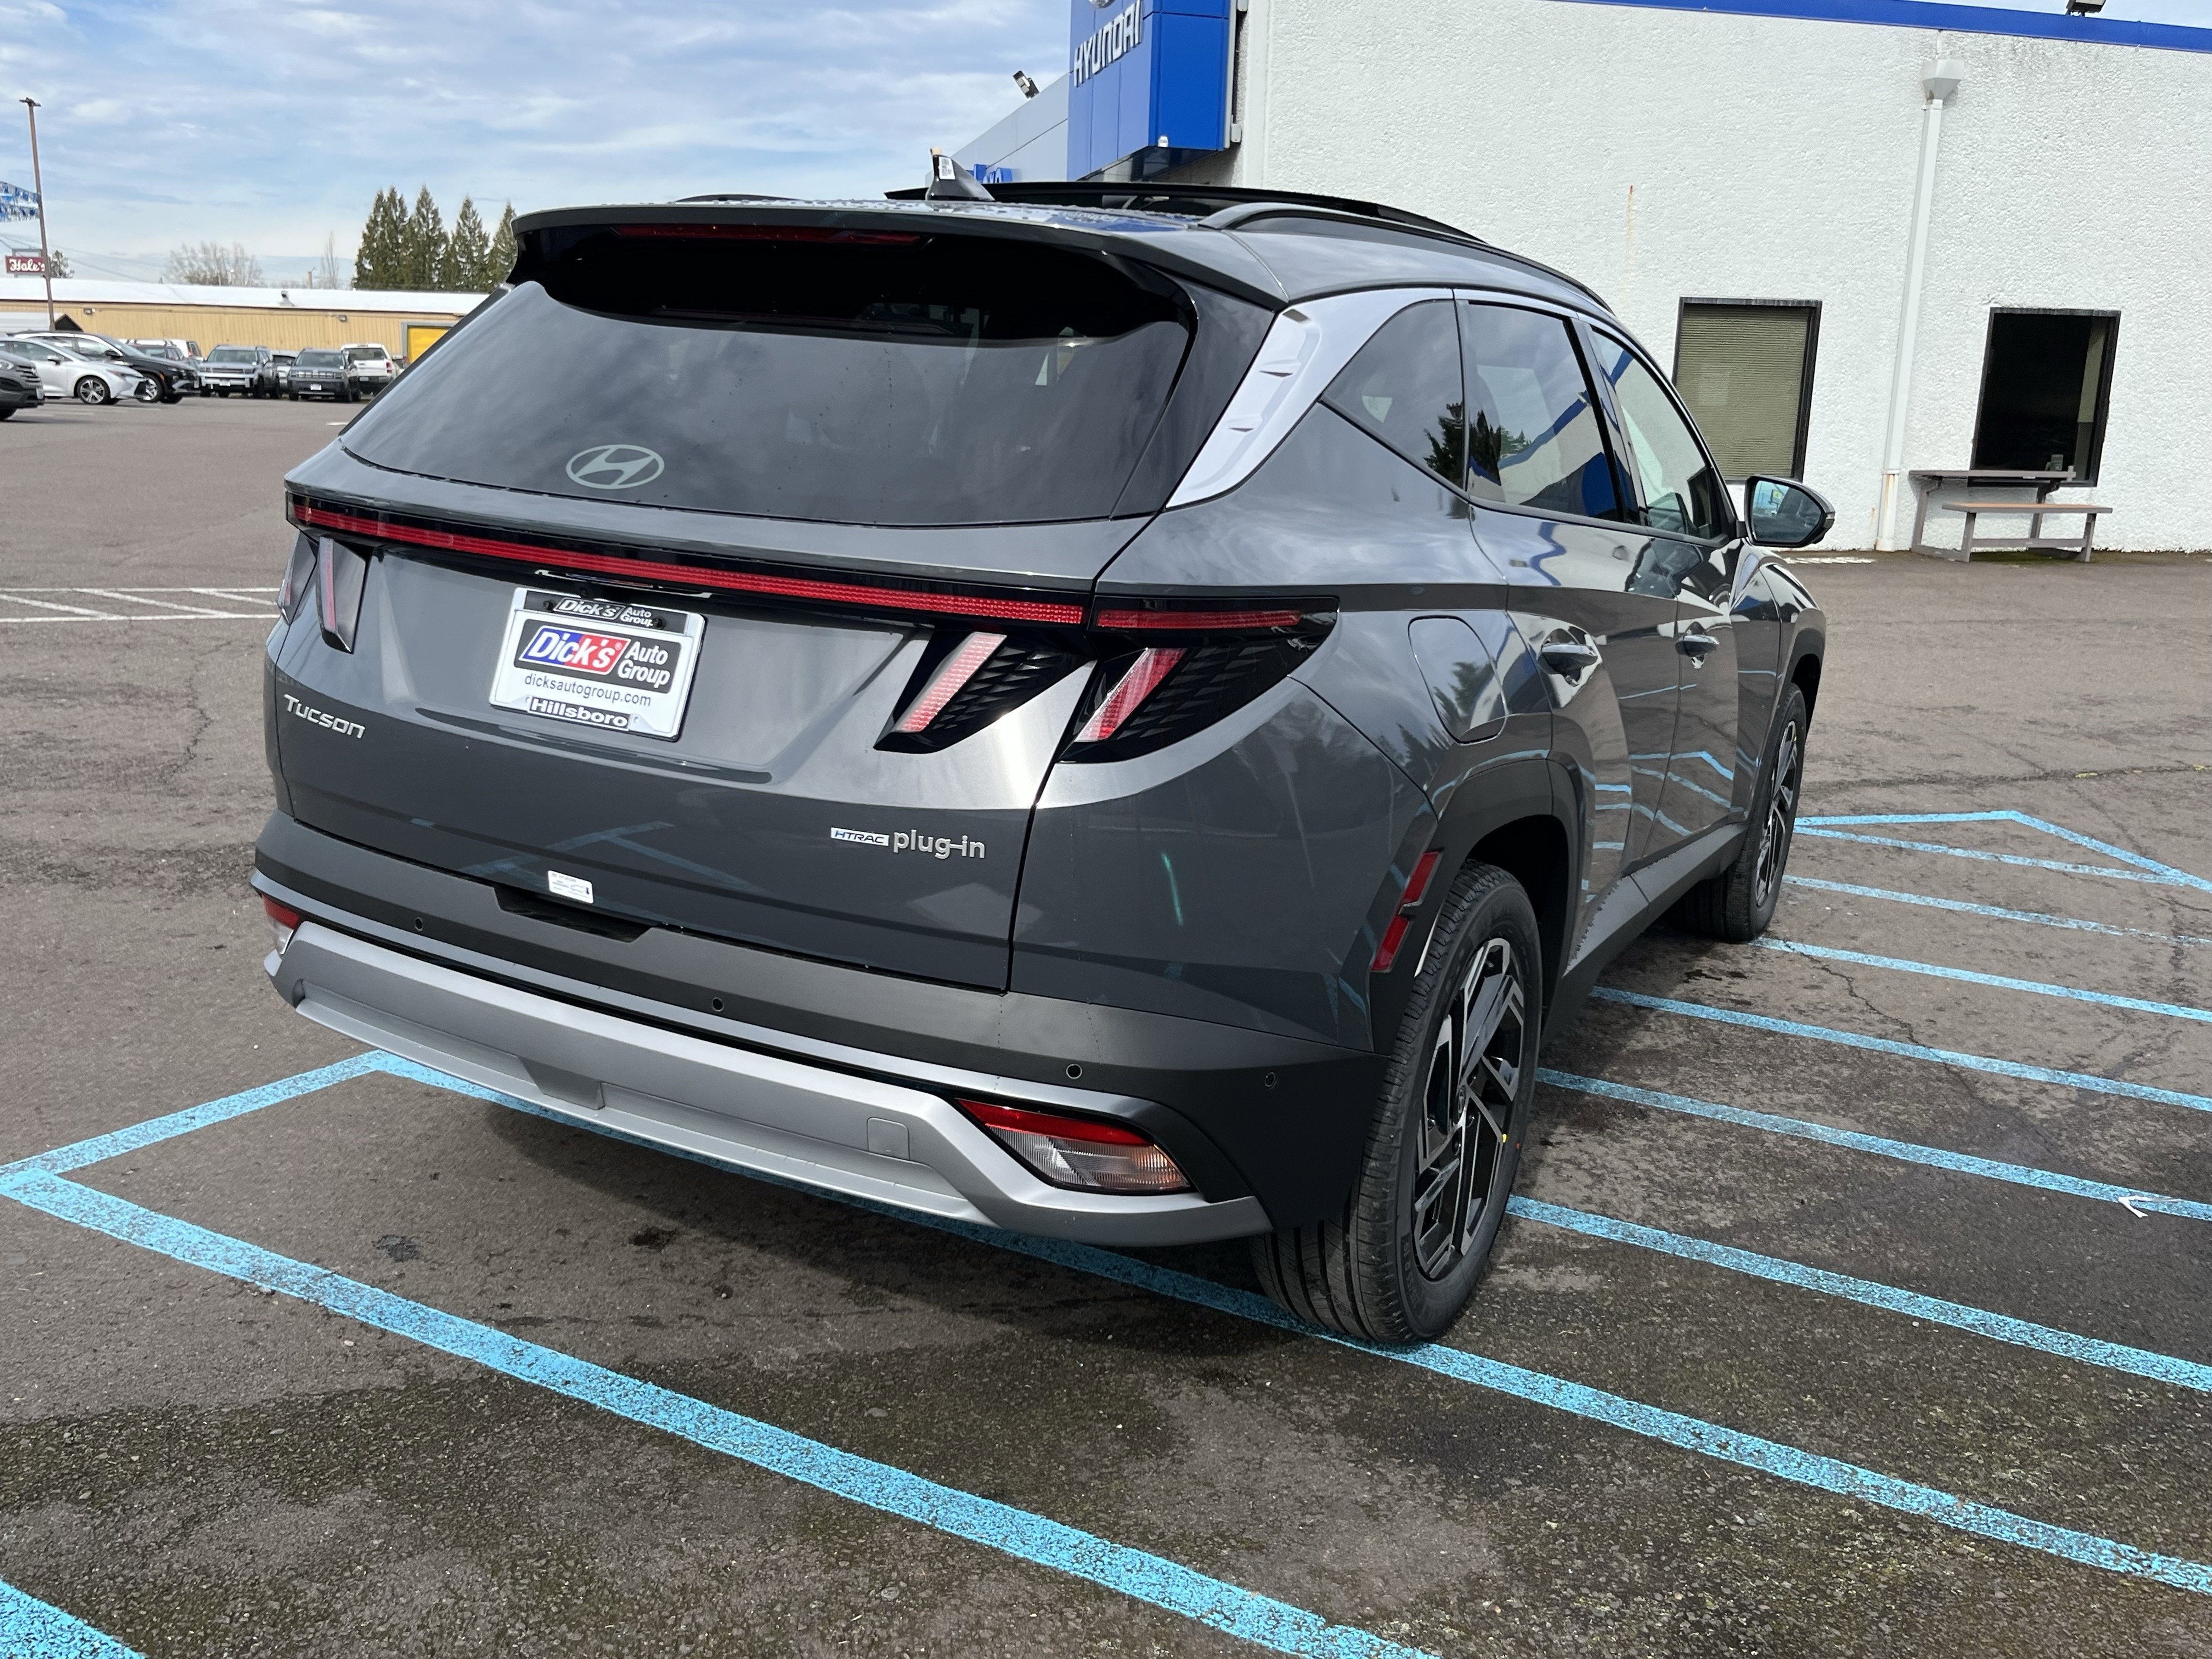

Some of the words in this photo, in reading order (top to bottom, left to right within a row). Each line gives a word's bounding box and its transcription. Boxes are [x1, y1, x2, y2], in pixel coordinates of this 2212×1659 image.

[1074, 0, 1141, 88] HYUNDAI
[9, 258, 45, 272] Hale's
[558, 599, 617, 617] Dick's
[625, 607, 652, 618] Auto
[527, 631, 616, 669] Dick's
[624, 641, 669, 665] Auto
[617, 659, 670, 689] Group
[524, 673, 652, 707] dicksautogroup.com
[531, 698, 628, 727] Hillsboro
[834, 830, 885, 844] HTRAC
[893, 828, 985, 860] plug-in
